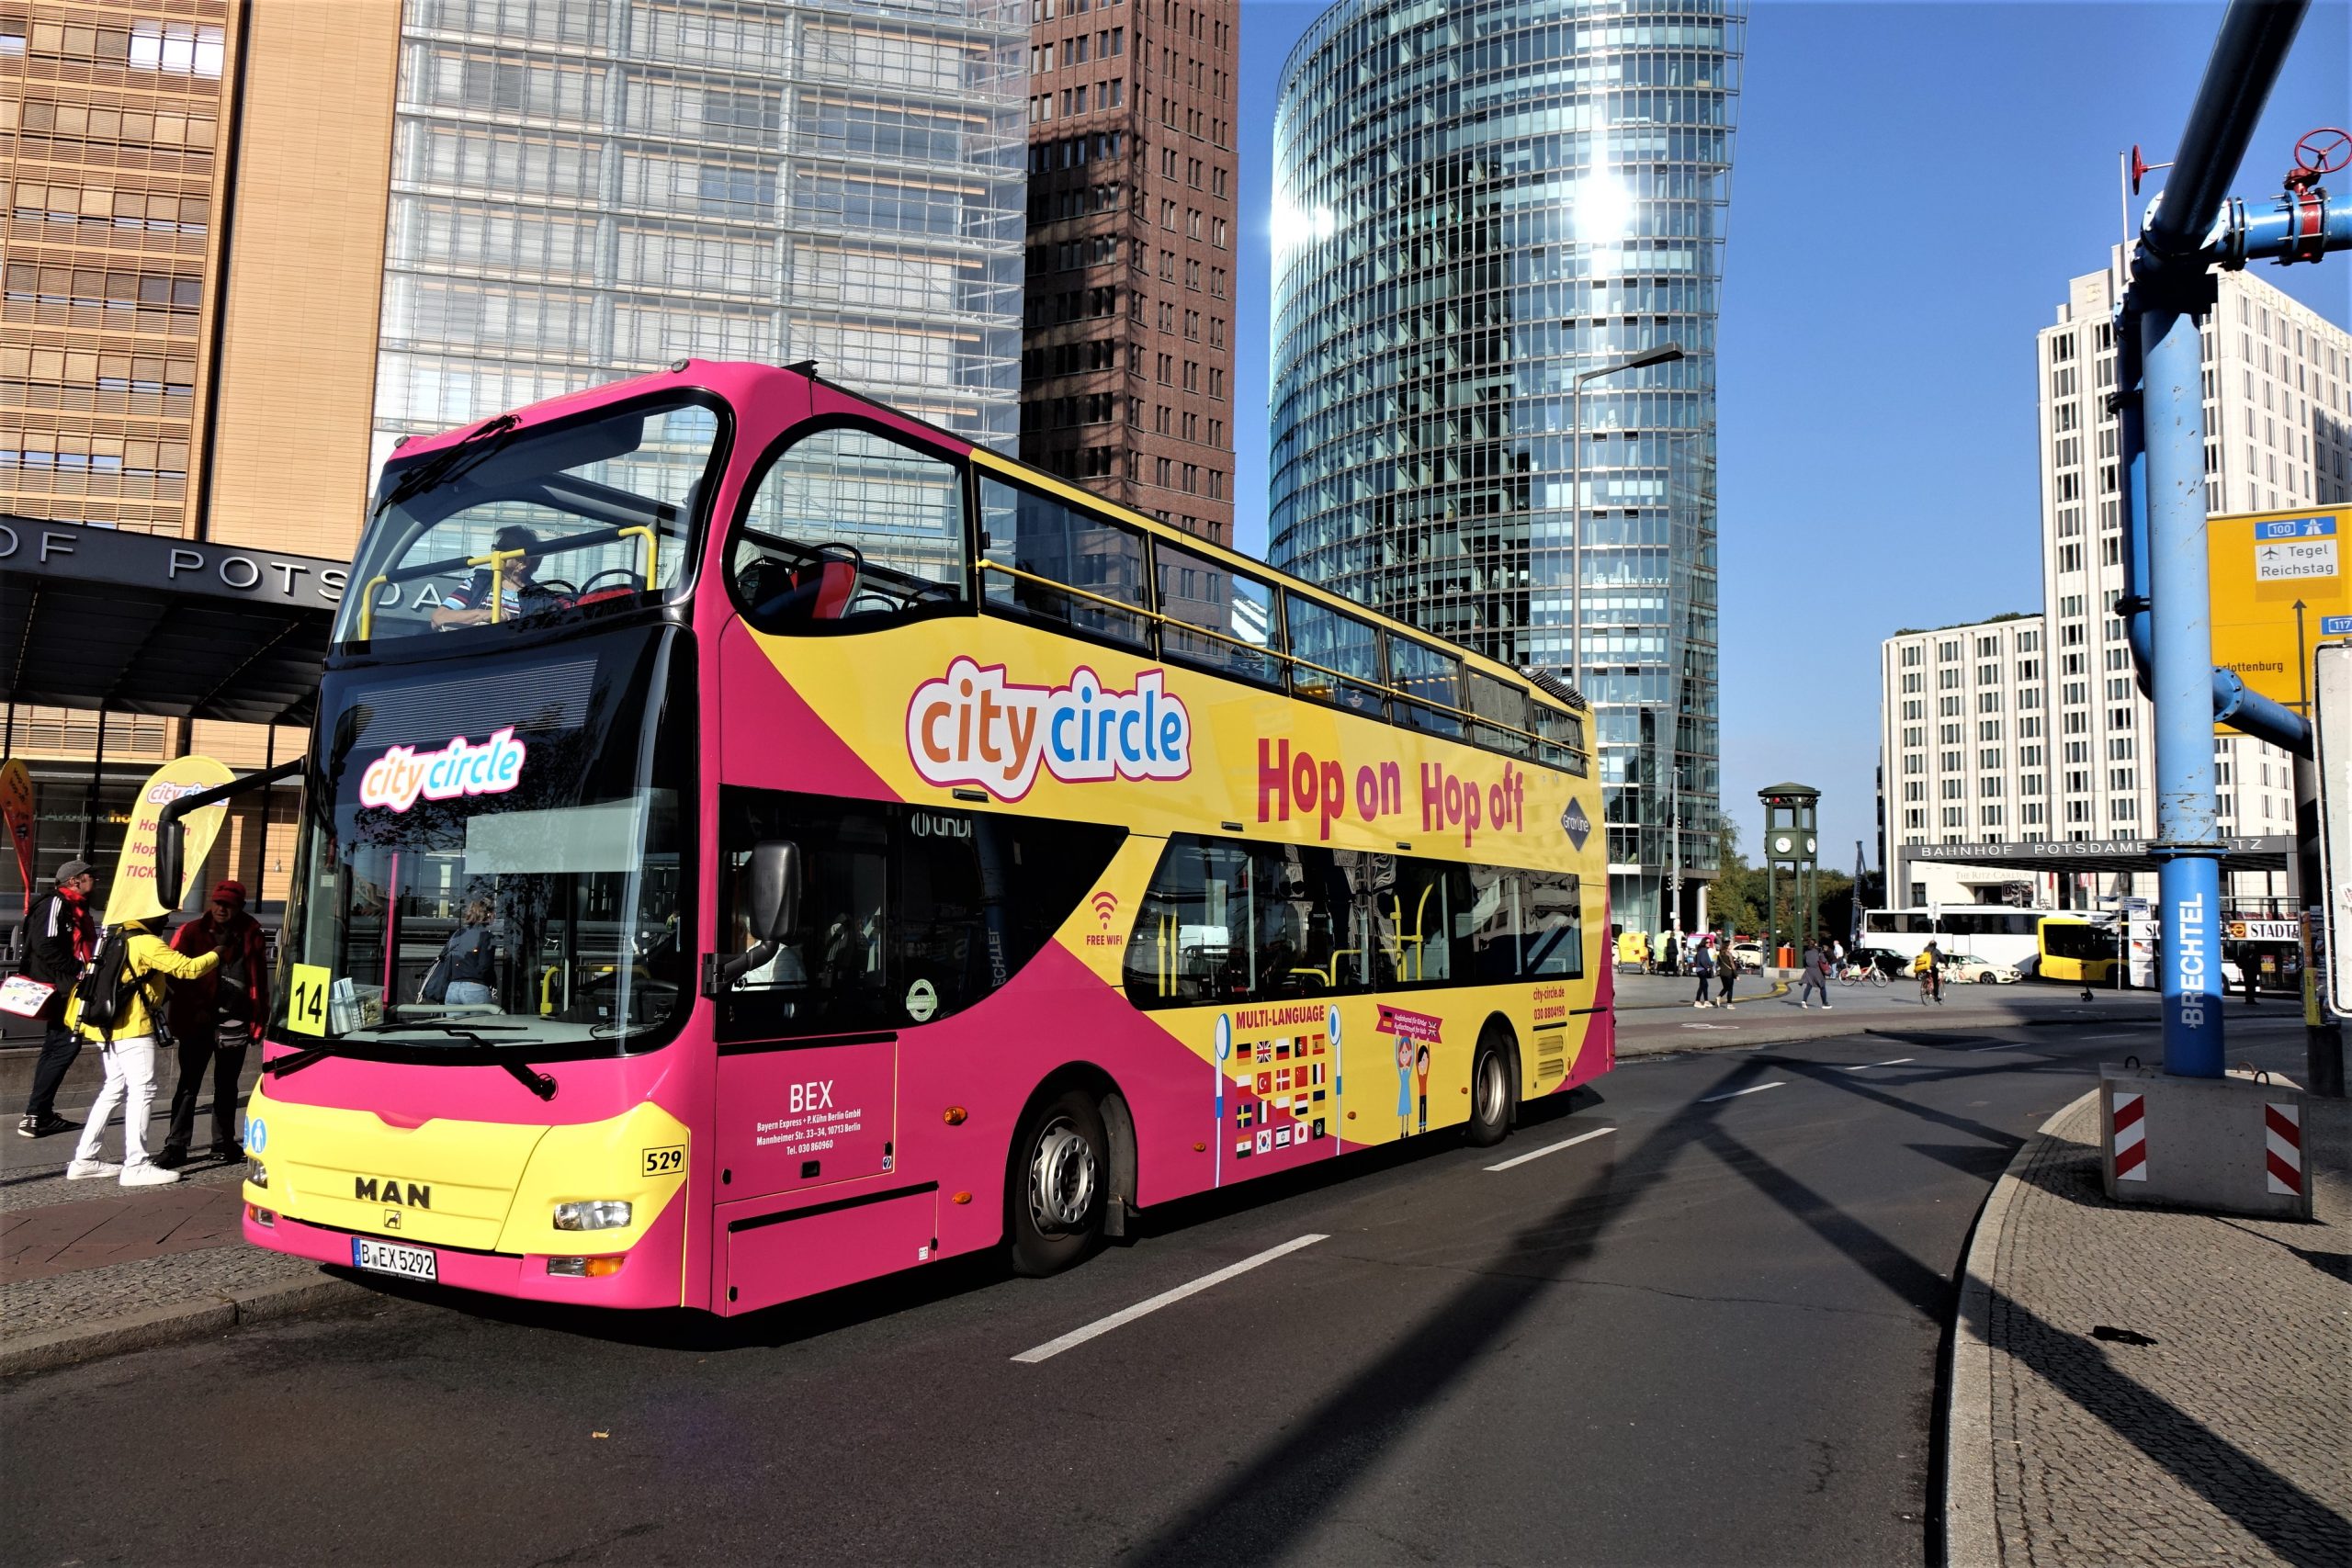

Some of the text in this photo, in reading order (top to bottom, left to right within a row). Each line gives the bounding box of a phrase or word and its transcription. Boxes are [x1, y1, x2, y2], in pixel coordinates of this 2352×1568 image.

[2273, 525, 2290, 534] 100
[2288, 544, 2328, 558] Tegel
[2261, 563, 2334, 577] Reichstag
[2335, 620, 2351, 630] 117
[2222, 660, 2284, 673] lottenburg
[922, 678, 1182, 781] city circle
[367, 740, 518, 802] city circle
[1257, 738, 1524, 849] Hop on Hop off
[139, 818, 158, 832] Ho
[1921, 844, 2014, 857] BAHNHOF
[2034, 841, 2148, 855] POTSDAME
[1086, 934, 1123, 946] FREE WIFI
[2179, 892, 2204, 1025] BRECHTEL
[294, 980, 323, 1024] 14
[1532, 985, 1565, 1003] city-circle.de
[1236, 1005, 1325, 1030] MULTI-LANGUAGE
[790, 1079, 833, 1113] BEX
[757, 1122, 778, 1133] Bayern
[779, 1118, 802, 1130] Express
[827, 1111, 844, 1122] Berlin
[844, 1108, 861, 1119] GmbH
[756, 1133, 795, 1146] Mannheimer
[795, 1130, 806, 1141] Str.
[828, 1123, 844, 1135] 10713
[844, 1122, 861, 1133] Berlin
[786, 1139, 833, 1156] Tel. 030 860960
[645, 1149, 682, 1172] 529
[355, 1176, 432, 1210] MAN
[361, 1243, 370, 1264] B
